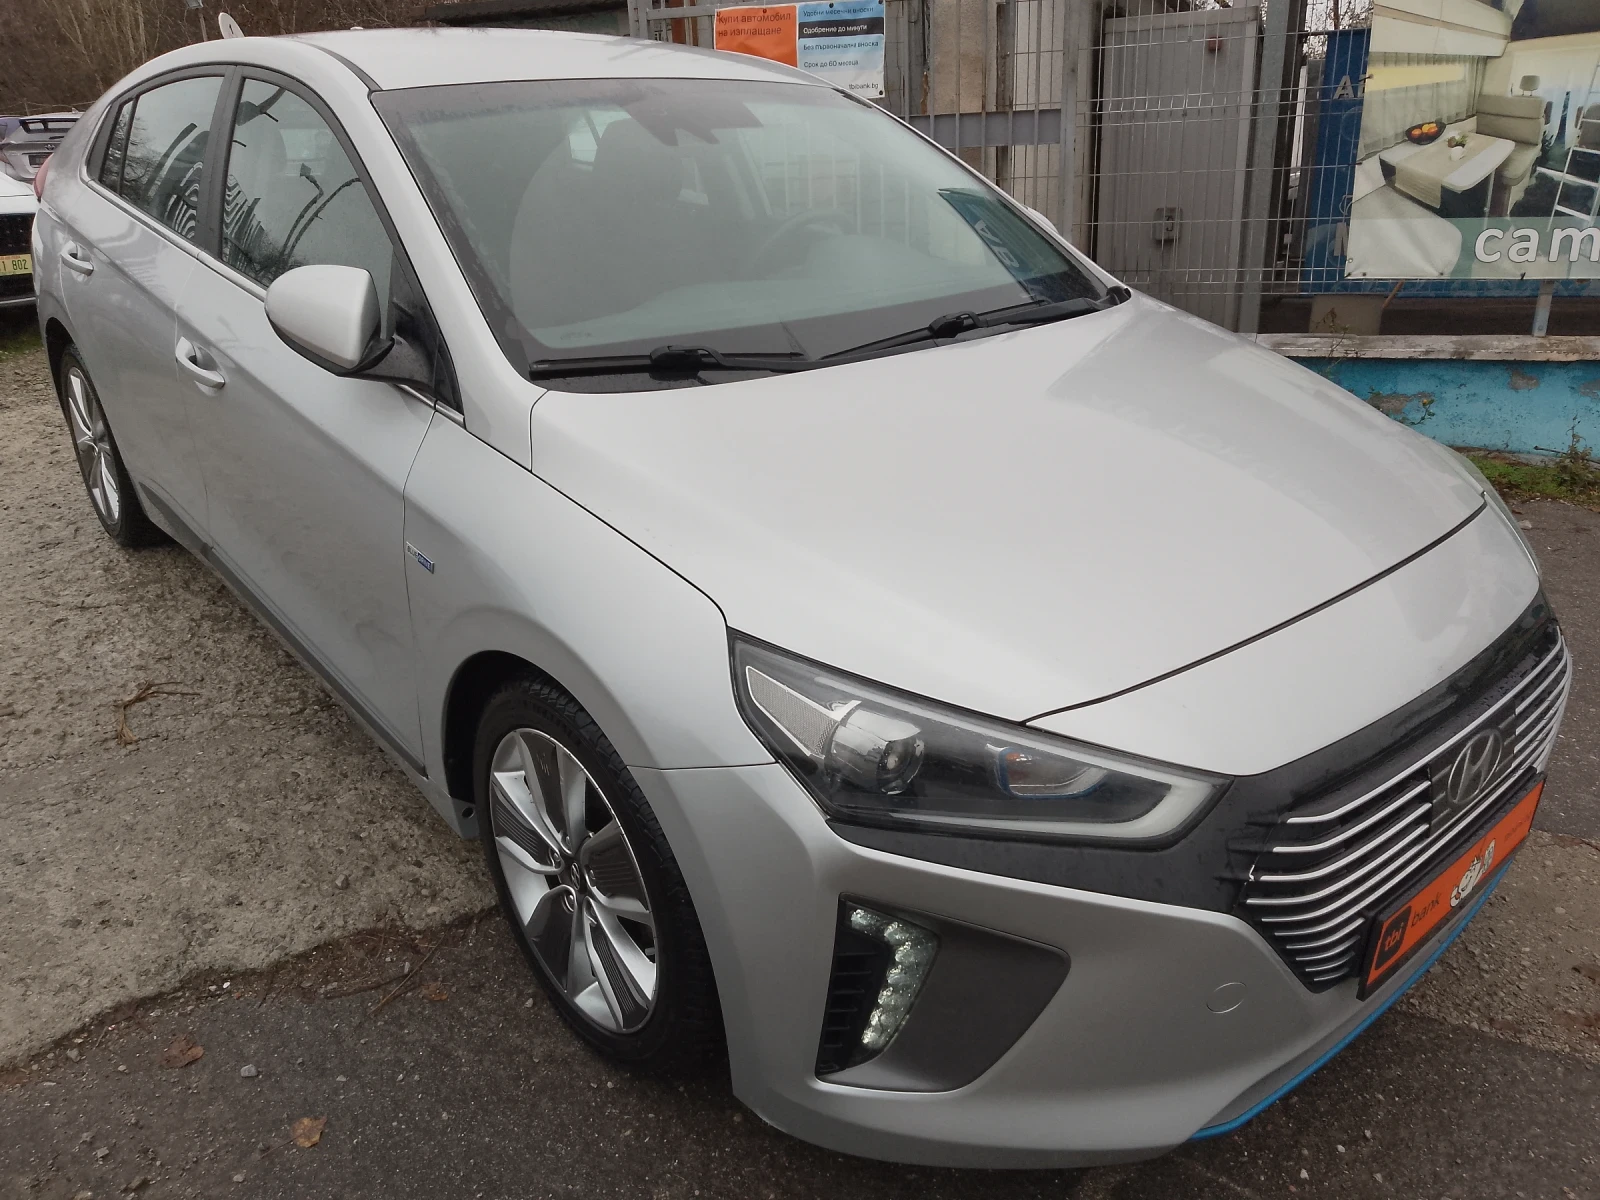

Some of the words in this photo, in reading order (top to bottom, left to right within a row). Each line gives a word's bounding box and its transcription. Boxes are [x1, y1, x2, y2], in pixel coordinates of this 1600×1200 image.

[718, 15, 739, 26] Купи
[741, 12, 791, 23] автомобил
[718, 29, 728, 37] на
[730, 26, 782, 36] изплащане
[803, 26, 837, 34] Одобрение
[847, 24, 868, 32] минути
[848, 82, 879, 90] tbibank.bg
[12, 259, 28, 270] 802
[1384, 921, 1405, 951] tbi
[1411, 892, 1442, 928] bank
